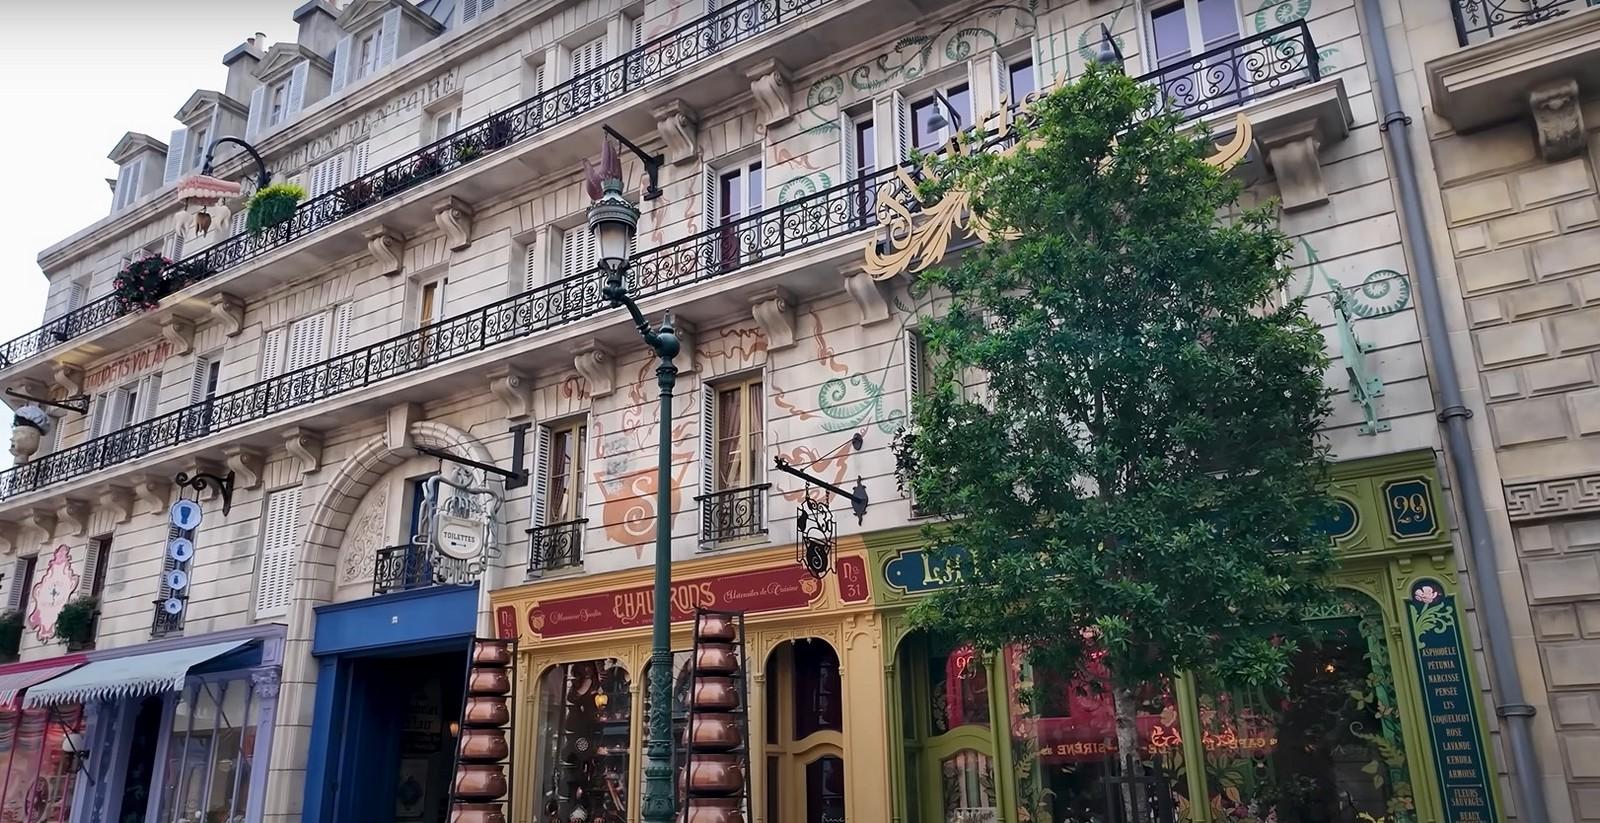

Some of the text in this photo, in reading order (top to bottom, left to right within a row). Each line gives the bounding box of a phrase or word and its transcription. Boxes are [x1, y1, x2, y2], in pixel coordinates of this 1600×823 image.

[1393, 493, 1427, 524] 29
[443, 531, 476, 543] TOILETTES
[847, 584, 860, 597] 31
[613, 581, 716, 625] CHAURONS
[1428, 673, 1460, 683] NARCISSE
[1443, 701, 1455, 710] LYS
[1446, 728, 1463, 737] ROSE
[1442, 741, 1471, 751] LAVANDE
